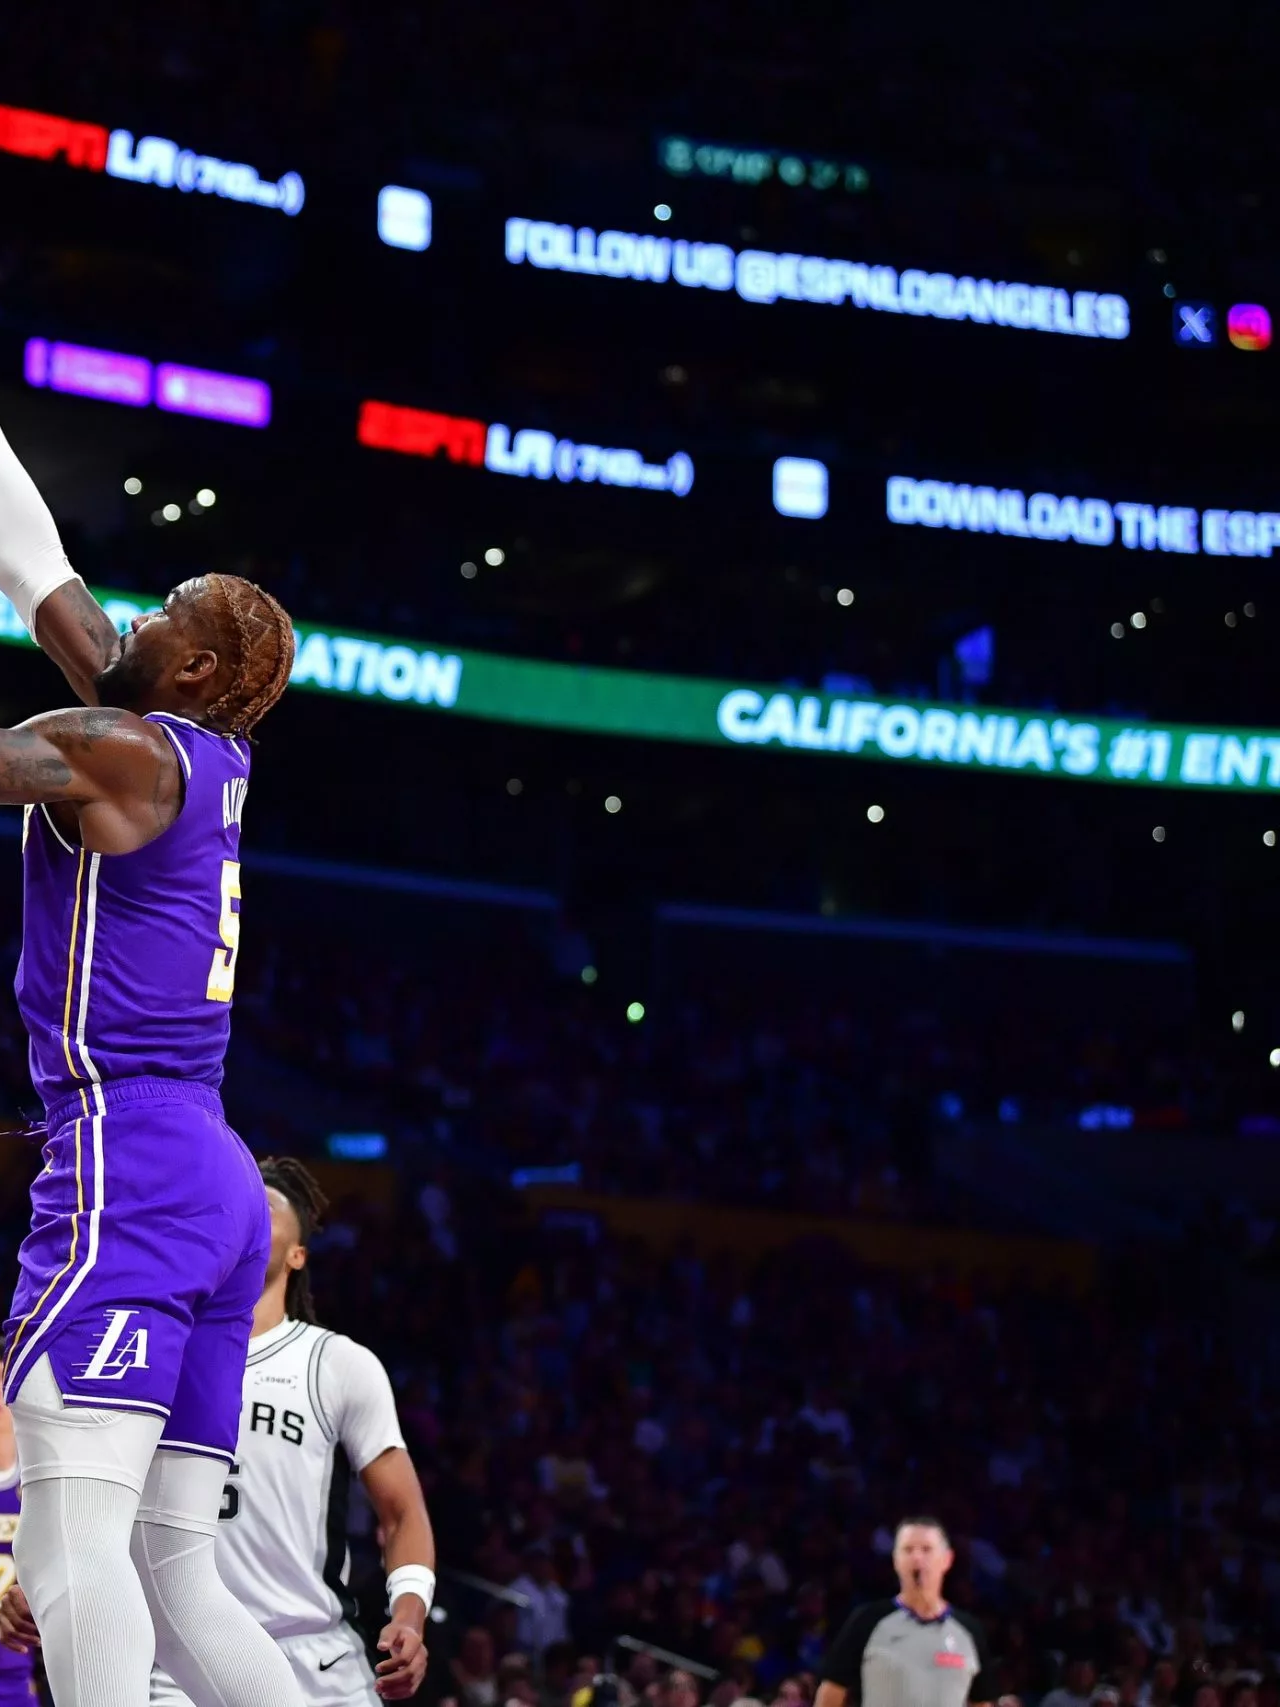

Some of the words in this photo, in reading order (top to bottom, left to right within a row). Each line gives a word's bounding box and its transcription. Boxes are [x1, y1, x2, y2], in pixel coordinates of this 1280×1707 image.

[506, 217, 673, 283] FOLLOW
[672, 239, 735, 290] US
[735, 249, 1131, 339] @ESPNLOSANGELES
[886, 475, 1115, 546] DOWNLOAD
[1113, 501, 1199, 554] THE
[717, 689, 1101, 777] CALIFORNIA'S
[1108, 727, 1172, 782] #1
[206, 859, 242, 1003] 5
[70, 1308, 151, 1381] LA
